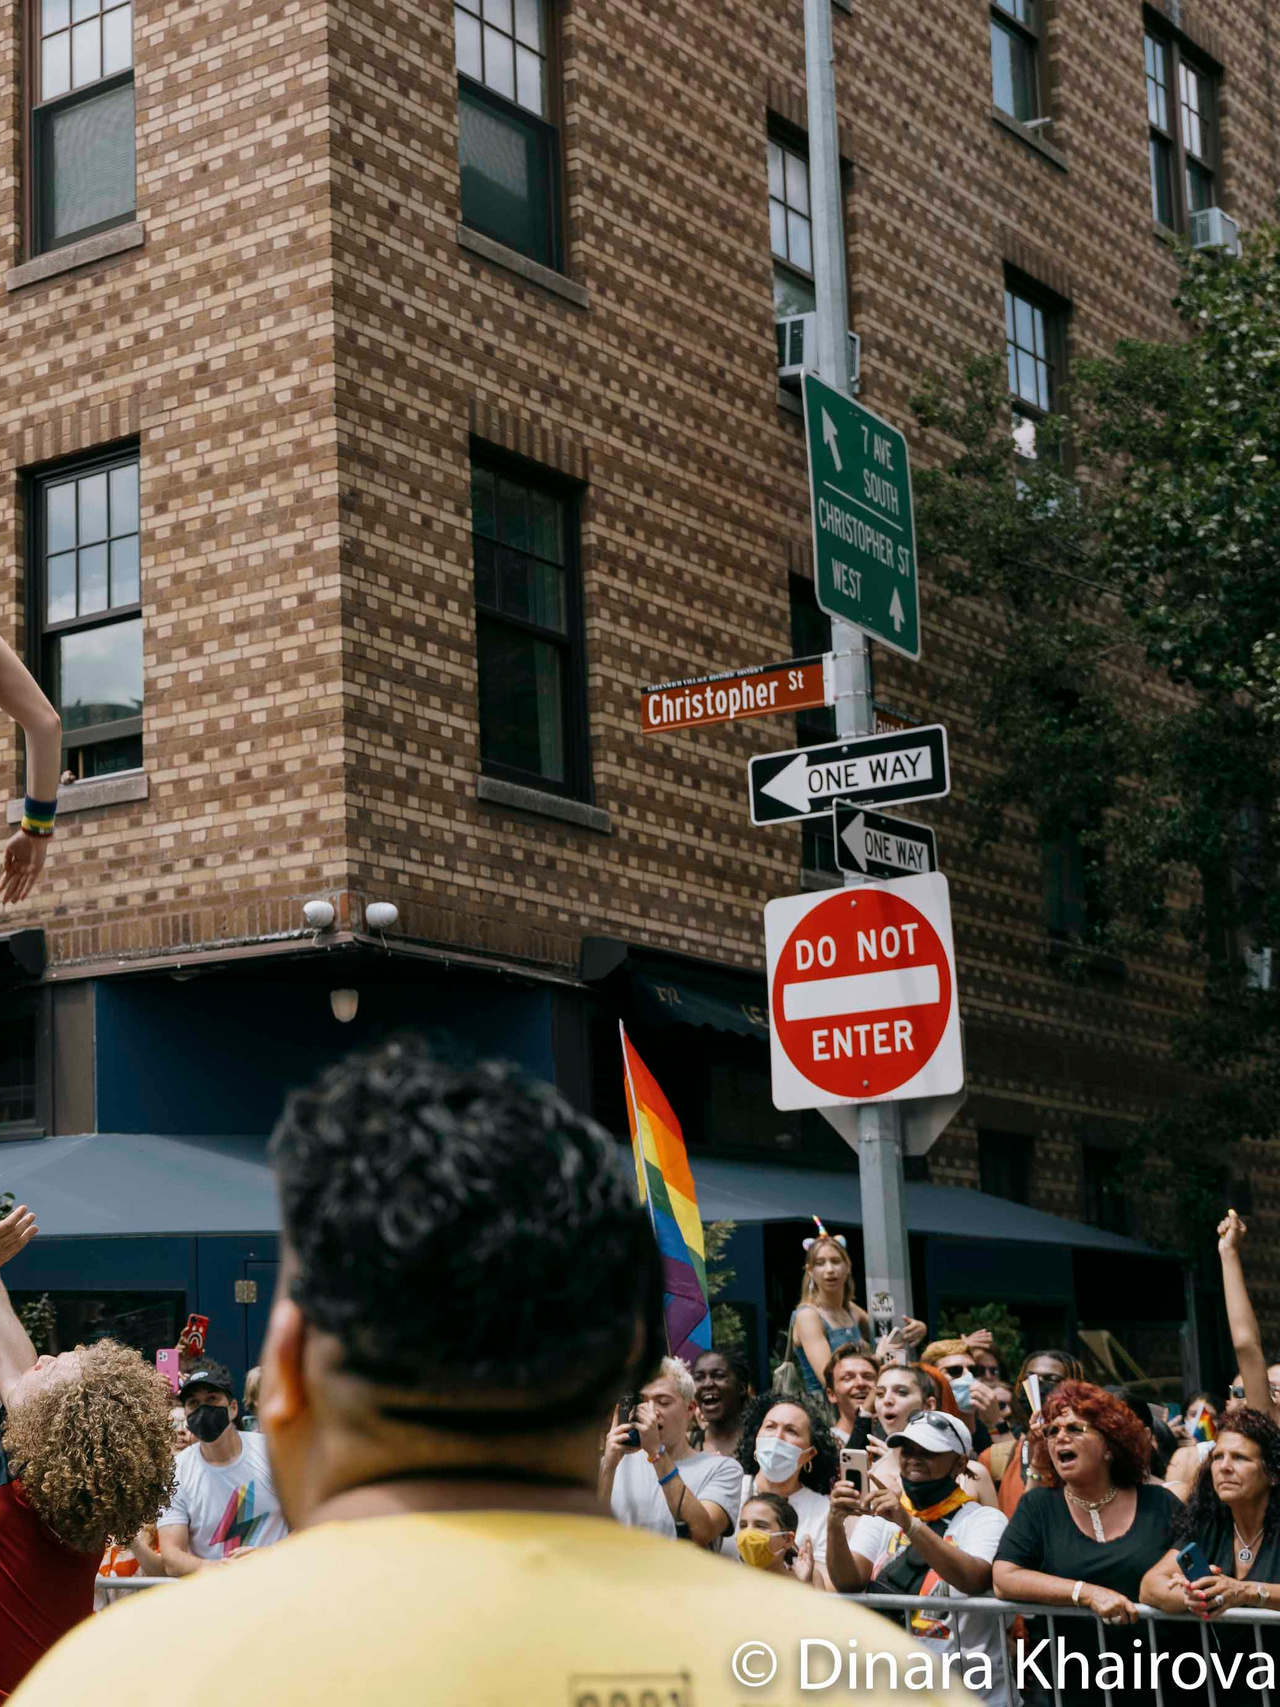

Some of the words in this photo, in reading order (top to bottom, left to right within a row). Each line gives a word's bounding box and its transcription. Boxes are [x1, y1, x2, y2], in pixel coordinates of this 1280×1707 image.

[860, 424, 870, 455] 7
[873, 432, 894, 472] AVE
[863, 467, 900, 516] SOUTH
[818, 496, 894, 569] CHRISTOPHER
[897, 545, 911, 577] ST
[831, 557, 862, 602] WEST
[647, 679, 779, 725] Christopher
[788, 669, 804, 692] St
[808, 763, 859, 794] ONE
[869, 751, 922, 784] WAY
[864, 830, 892, 861] ONE
[895, 840, 925, 869] WAY
[795, 935, 837, 971] DO
[857, 922, 919, 962] NOT
[812, 1020, 914, 1061] ENTER
